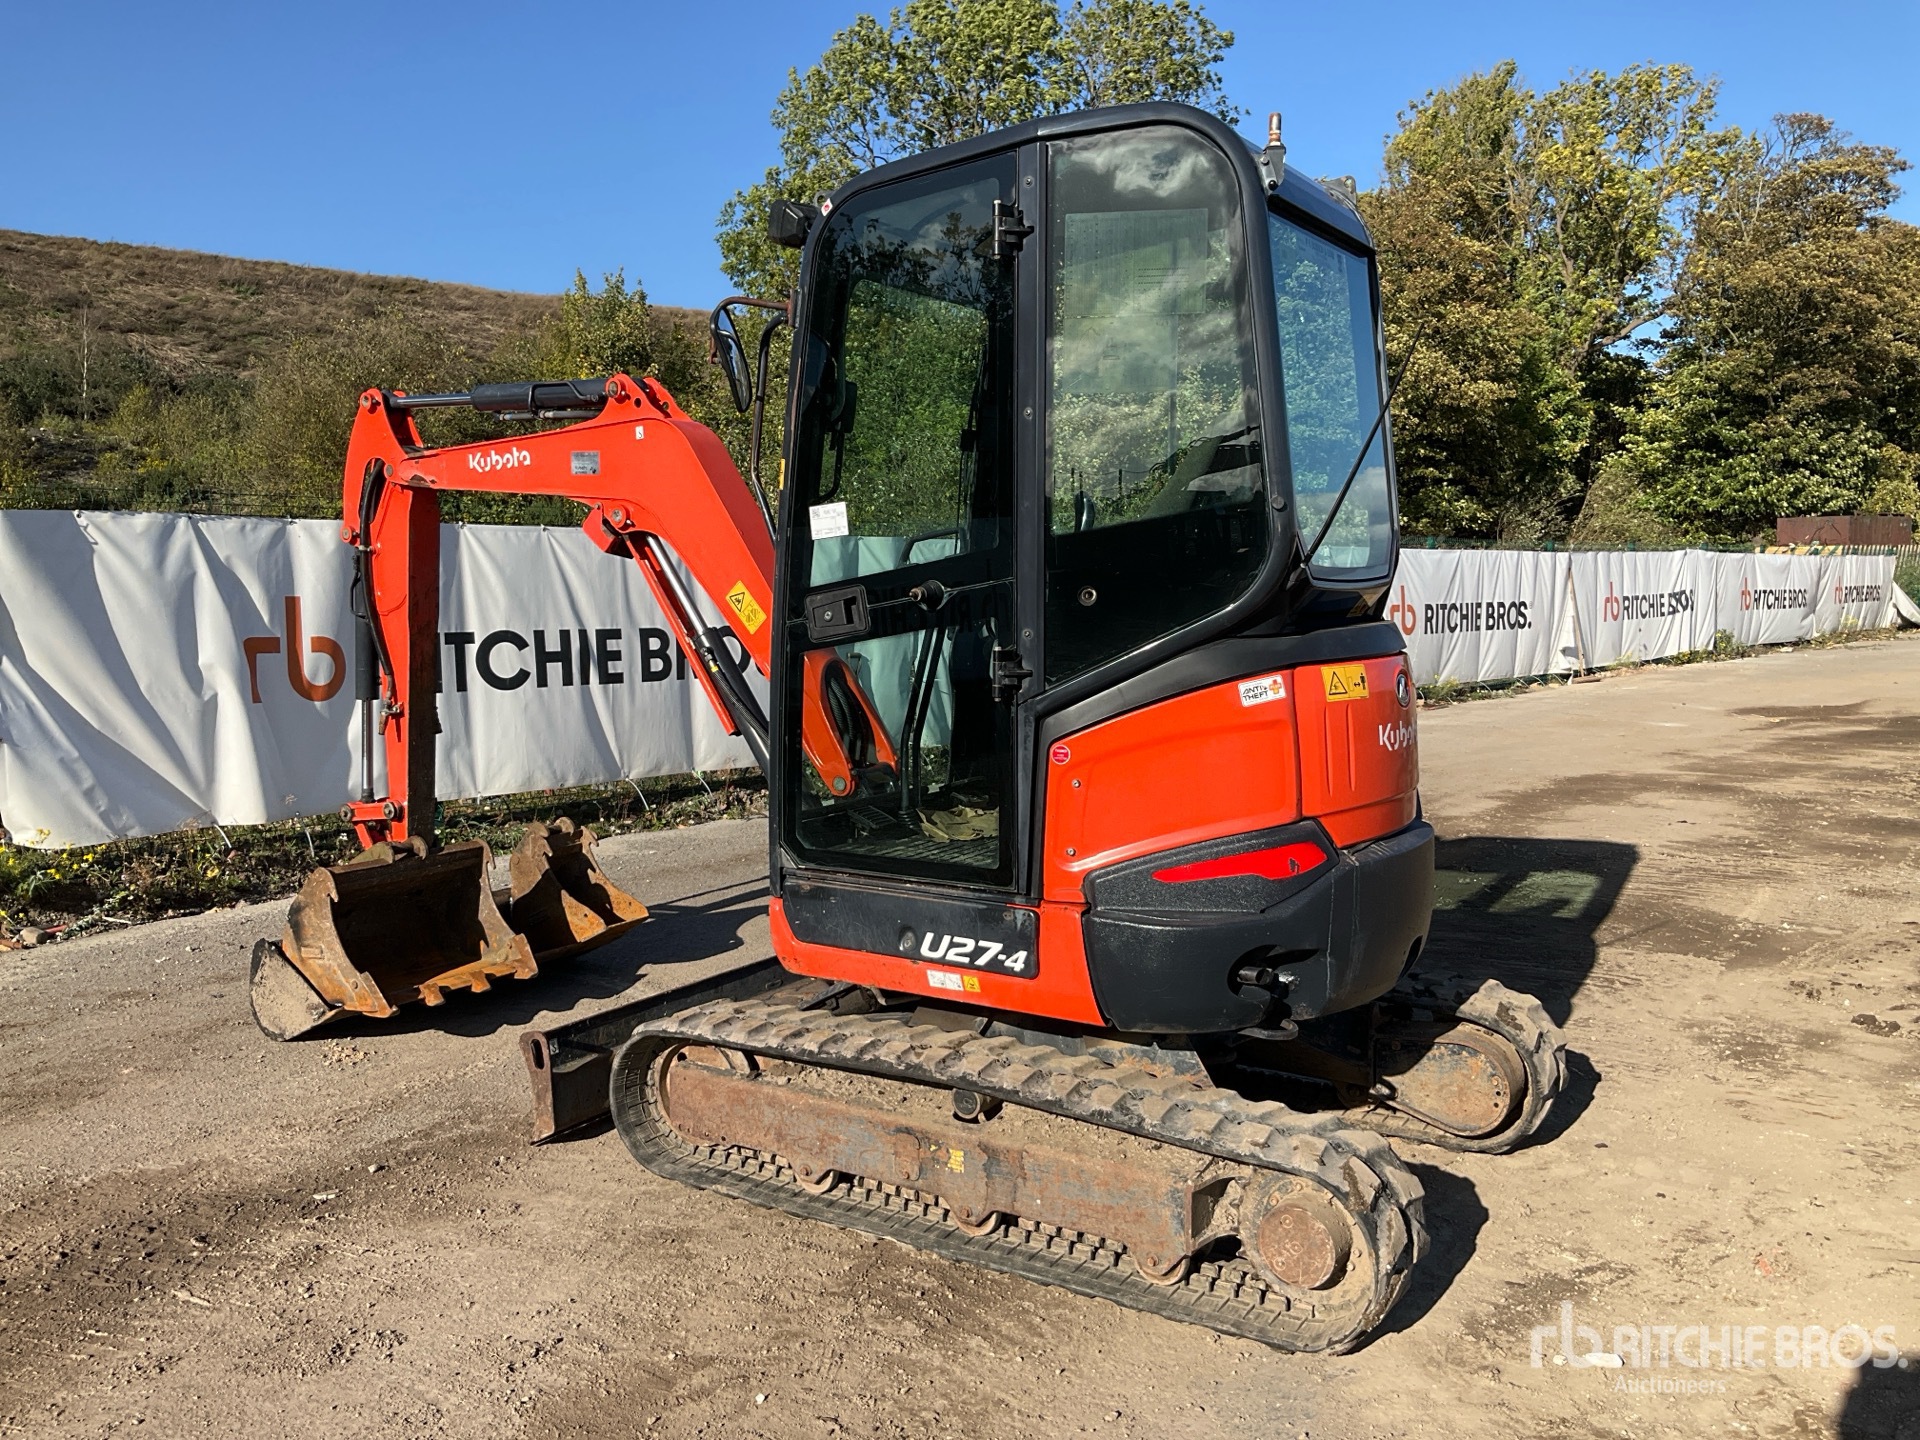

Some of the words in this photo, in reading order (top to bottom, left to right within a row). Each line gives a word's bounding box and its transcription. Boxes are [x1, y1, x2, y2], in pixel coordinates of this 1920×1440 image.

[468, 446, 531, 473] Kubota
[1424, 602, 1482, 635] RITCHIE
[1485, 600, 1532, 631] BROS.
[1622, 592, 1665, 621] RITCHIE
[243, 596, 347, 704] rb
[1242, 690, 1269, 702] THEFT
[920, 931, 1028, 972] U27-4
